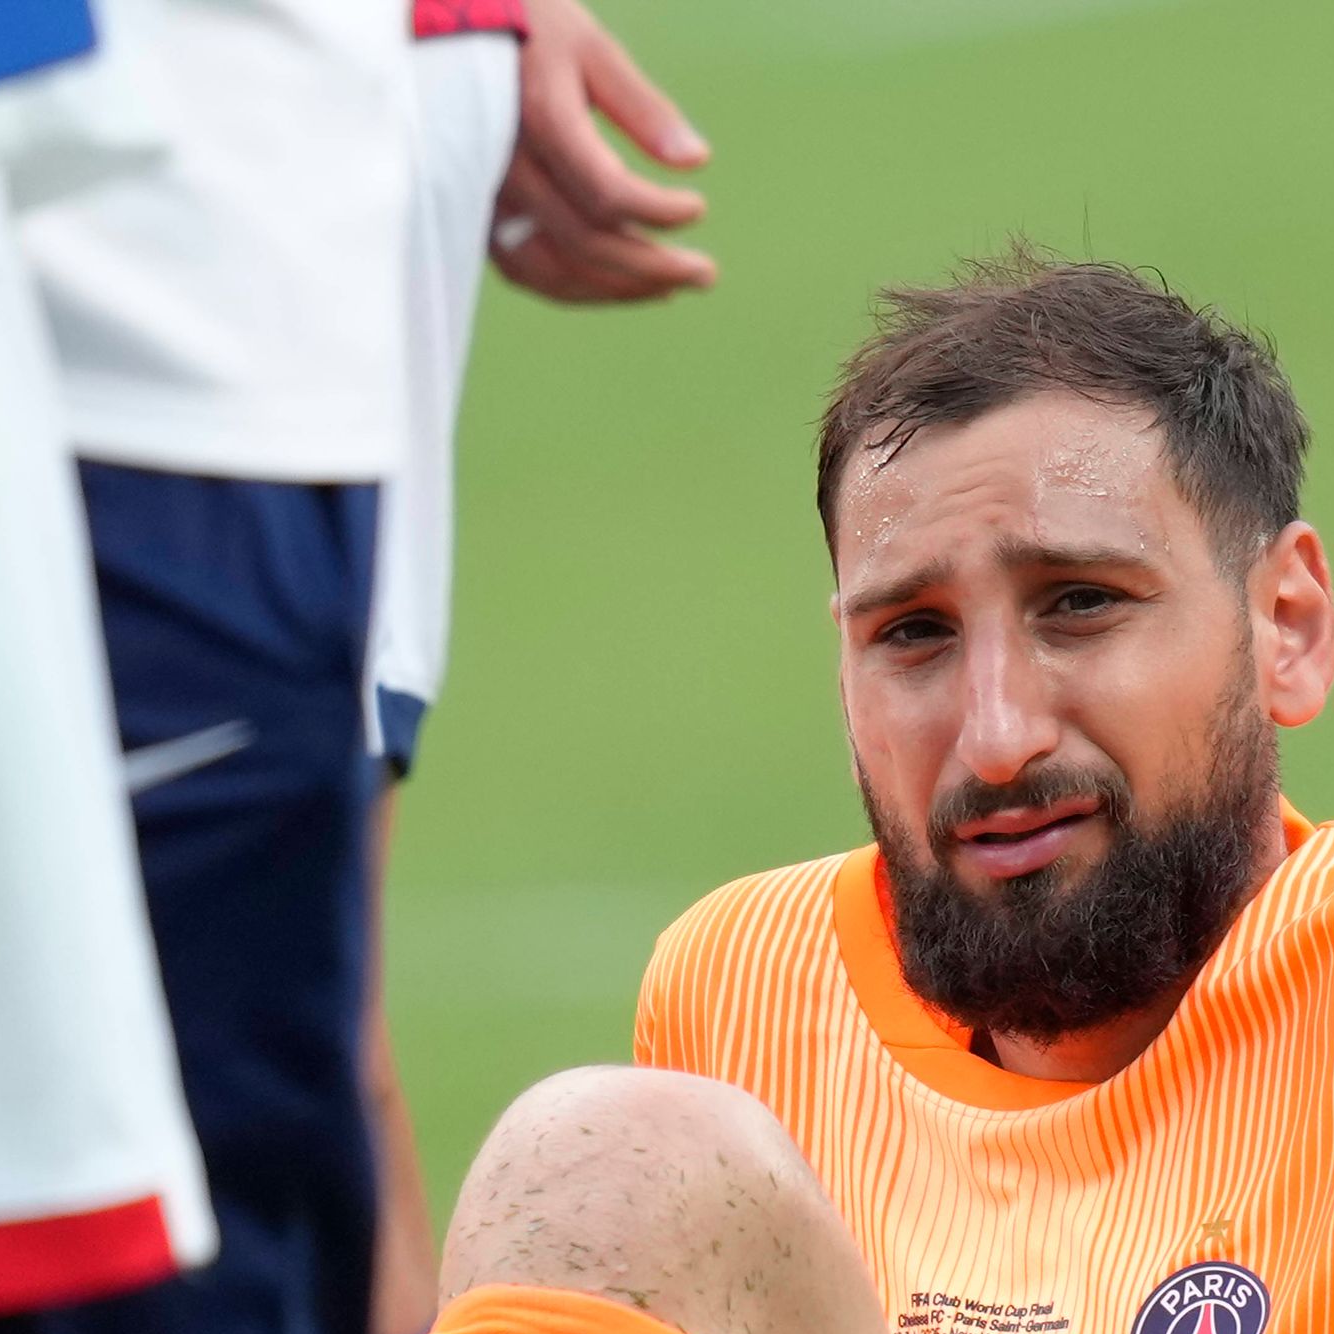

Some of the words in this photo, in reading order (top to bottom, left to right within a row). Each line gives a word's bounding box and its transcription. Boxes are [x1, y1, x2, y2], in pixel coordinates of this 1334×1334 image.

[932, 1292, 961, 1309] Club
[964, 1298, 1003, 1317] World
[1004, 1304, 1027, 1320] Cup
[1029, 1301, 1055, 1316] Final
[1160, 1274, 1252, 1316] PARIS
[898, 1312, 929, 1328] Chelsea
[930, 1309, 945, 1324] FC
[953, 1312, 987, 1329] Paris
[989, 1317, 1070, 1333] Saint-Germain
